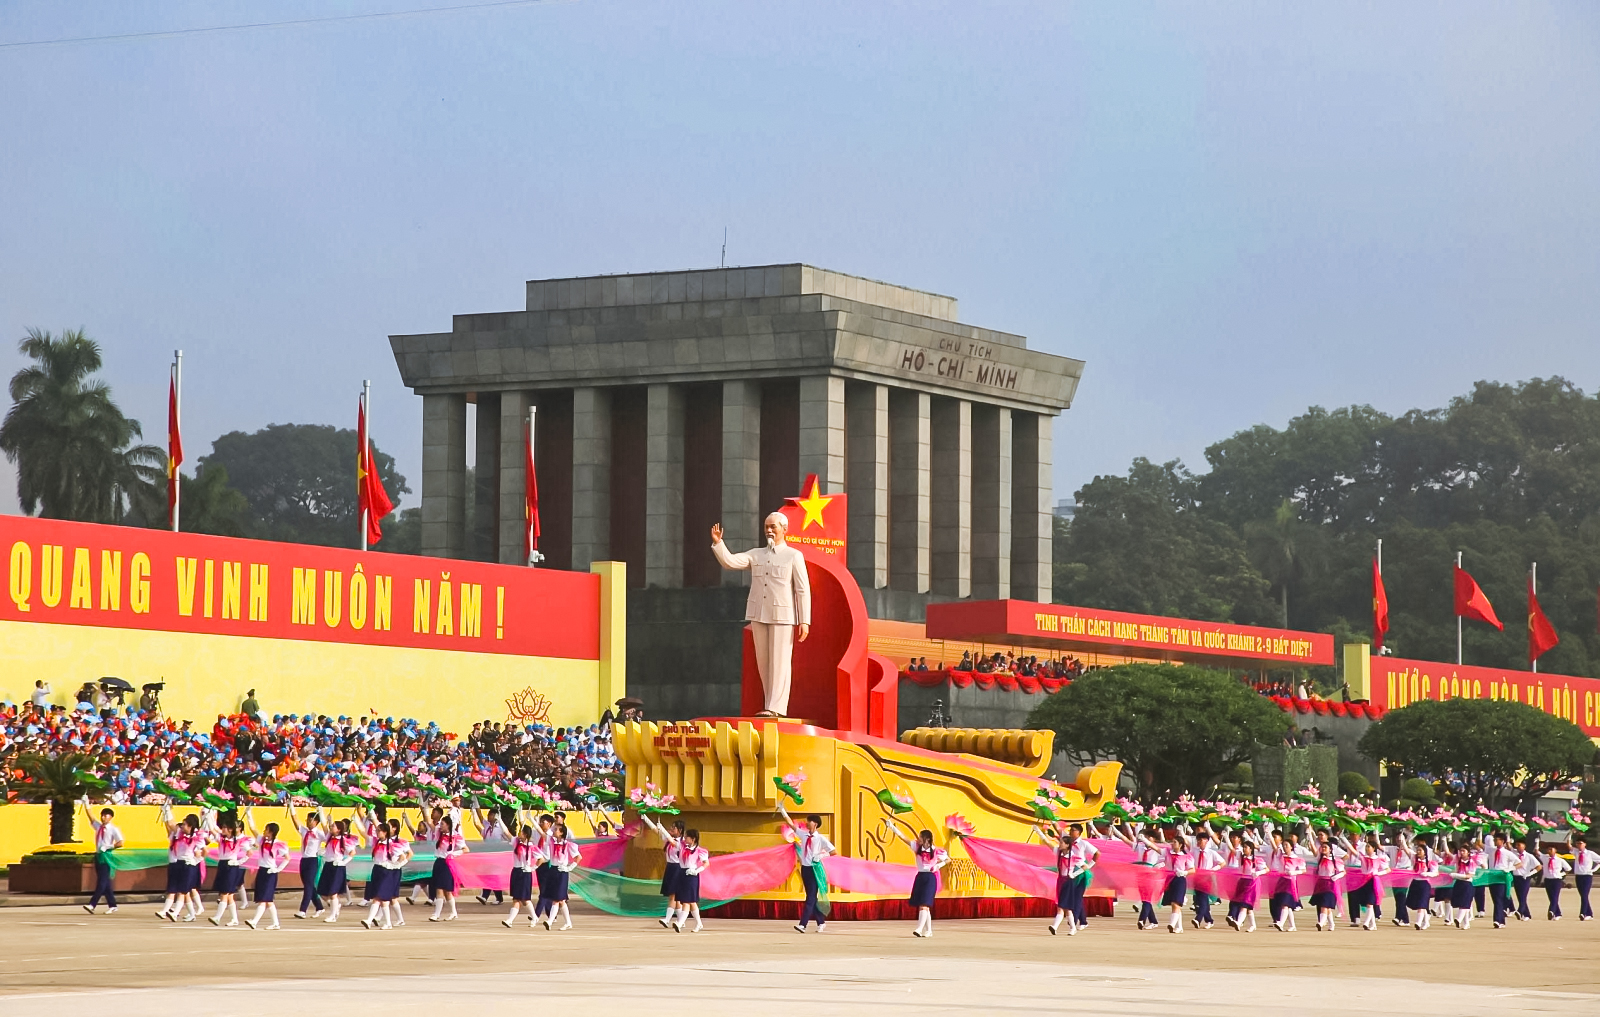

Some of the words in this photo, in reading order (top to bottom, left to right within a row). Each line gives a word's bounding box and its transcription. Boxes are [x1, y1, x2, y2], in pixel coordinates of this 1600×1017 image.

[9, 541, 151, 613] QUANG
[176, 556, 269, 622] VINH
[291, 562, 392, 631] MUÔN
[413, 571, 482, 638] NĂM
[1035, 613, 1058, 632] TINH
[1060, 612, 1086, 635] THẦN
[1087, 616, 1111, 638] CÁCH
[1113, 621, 1138, 642] MẠNG
[1139, 623, 1169, 644] THÁNG
[1170, 625, 1189, 646] TÁM
[1191, 627, 1203, 647] VÀ
[1204, 628, 1226, 649] QUỐC
[1227, 632, 1255, 652] KHÁNH
[1273, 635, 1290, 655] BẤT
[1387, 667, 1431, 710] NƯỚC
[1527, 680, 1544, 711] XÃ
